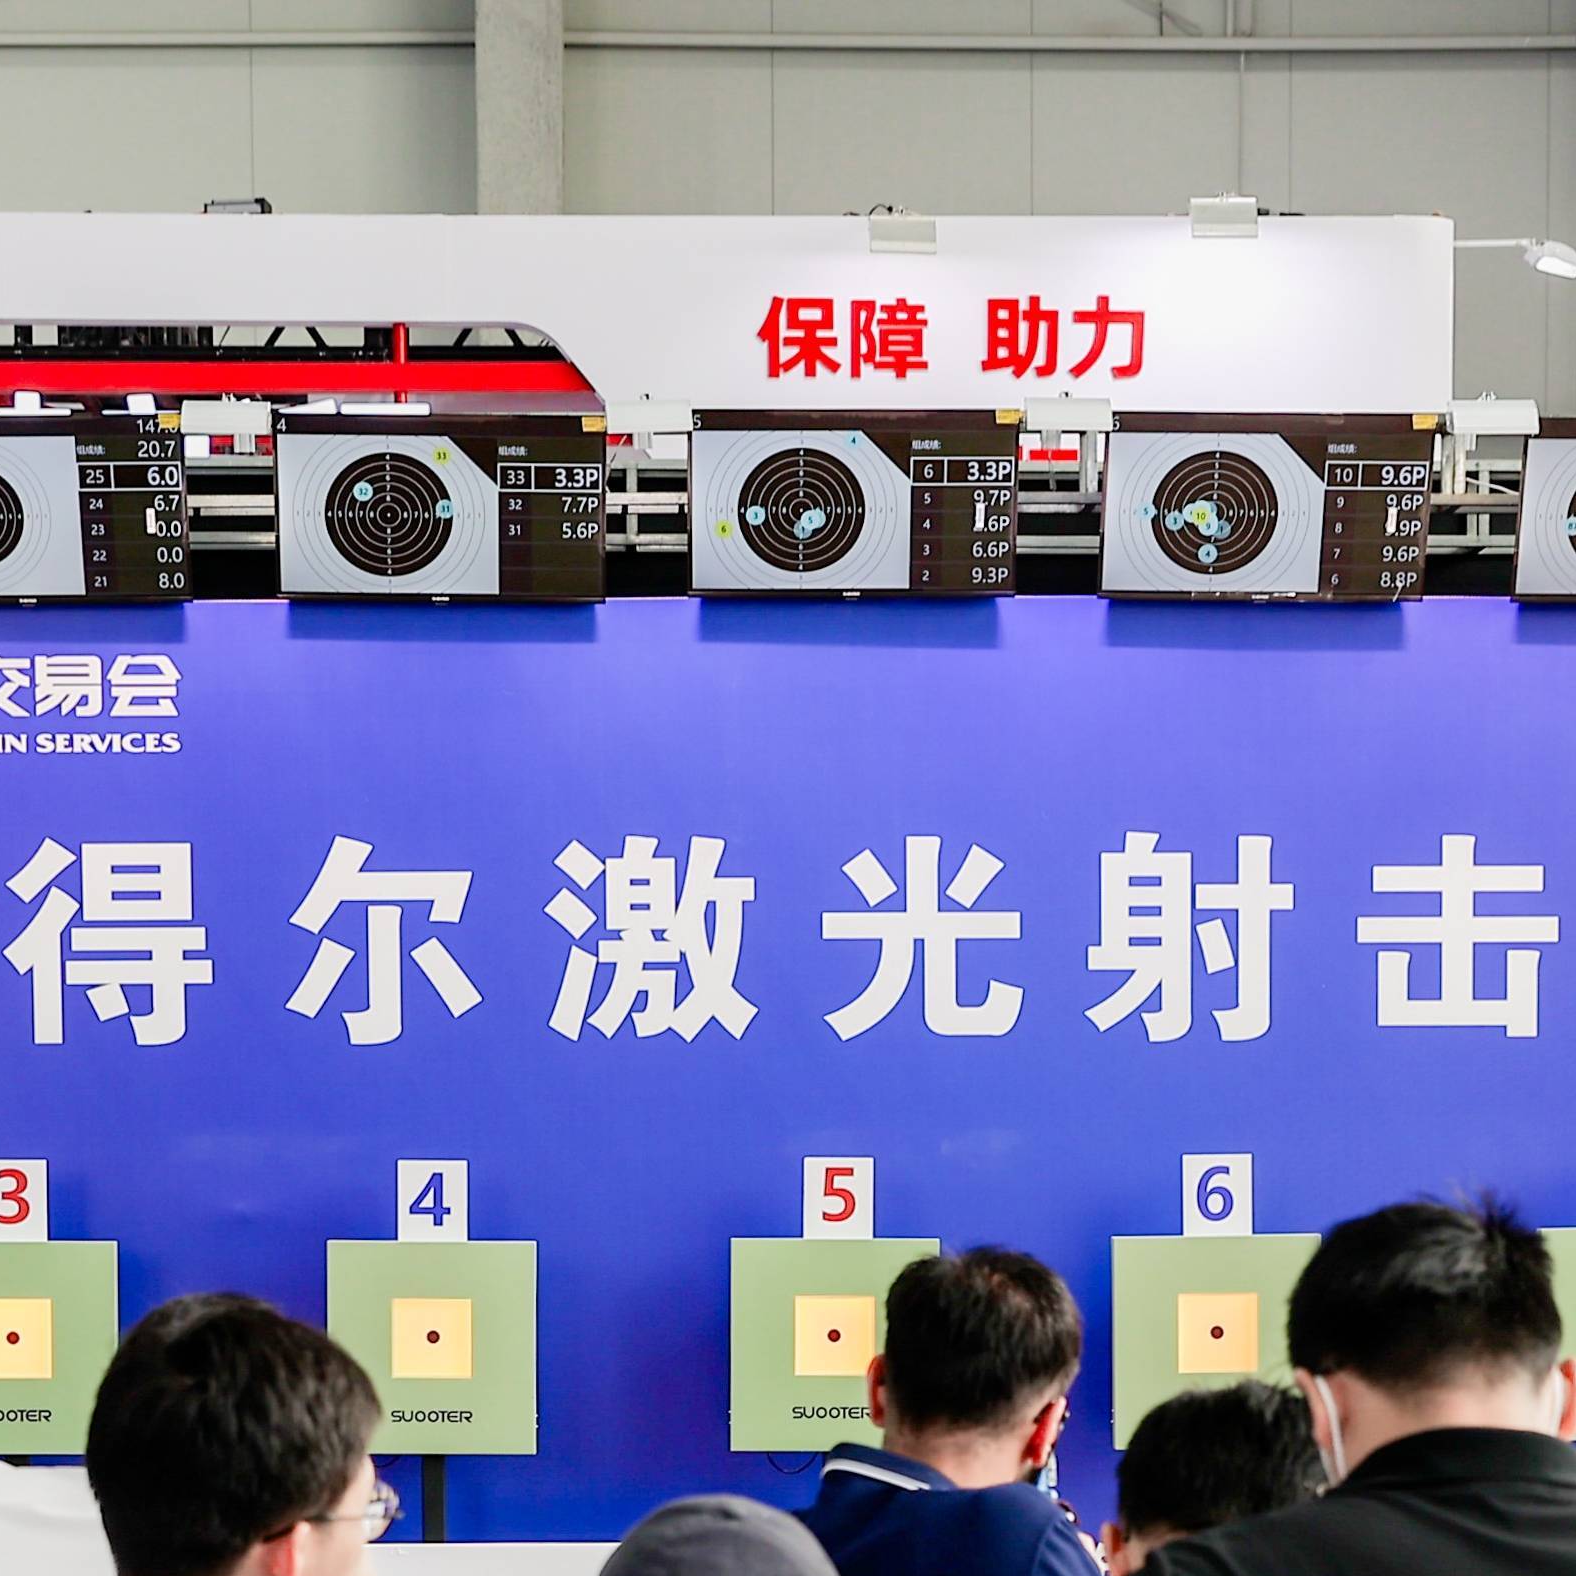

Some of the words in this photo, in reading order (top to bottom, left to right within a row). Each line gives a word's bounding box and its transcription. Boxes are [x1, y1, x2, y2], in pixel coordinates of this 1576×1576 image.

[756, 295, 928, 380] 保障
[981, 295, 1145, 380] 助力
[277, 418, 287, 432] 4
[693, 415, 702, 428] 5
[137, 441, 175, 458] 20.7
[86, 470, 104, 484] 25
[147, 467, 177, 486] 6.0
[506, 471, 524, 484] 33
[555, 469, 598, 488] 3.3P
[924, 465, 933, 478] 6
[967, 461, 1011, 481] 3.3P
[1335, 469, 1353, 482] 10
[1381, 466, 1425, 486] 9.6P
[89, 499, 103, 510] 24
[154, 495, 179, 511] 6.7
[508, 499, 522, 511] 32
[562, 497, 599, 512] 7.7P
[924, 493, 931, 504] 5
[974, 490, 1011, 506] 9.7P
[1337, 497, 1344, 508] 9
[1387, 494, 1424, 511] 9.6P
[91, 524, 104, 536] 23
[156, 521, 181, 537] 0.0
[508, 524, 521, 536] 31
[562, 522, 599, 539] 5.6P
[923, 519, 931, 530] 4
[973, 516, 1010, 532] .6P
[1335, 522, 1343, 534] 8
[1384, 521, 1422, 537] .9P
[93, 550, 107, 561] 22
[157, 547, 183, 563] 0.0
[923, 545, 930, 556] 3
[973, 542, 1009, 558] 6.6P
[1334, 548, 1341, 560] 7
[1383, 546, 1419, 562] 9.6P
[94, 576, 107, 587] 21
[159, 573, 184, 589] 8.0
[922, 570, 930, 582] 2
[972, 568, 1009, 584] 9.3P
[1331, 573, 1339, 585] 6
[1381, 572, 1417, 588] 8.8P
[34, 733, 182, 756] SERVICES
[409, 1171, 452, 1227] 4
[821, 1166, 856, 1222] 5
[1196, 1166, 1234, 1222] 6
[391, 1409, 473, 1424] SUOOTER
